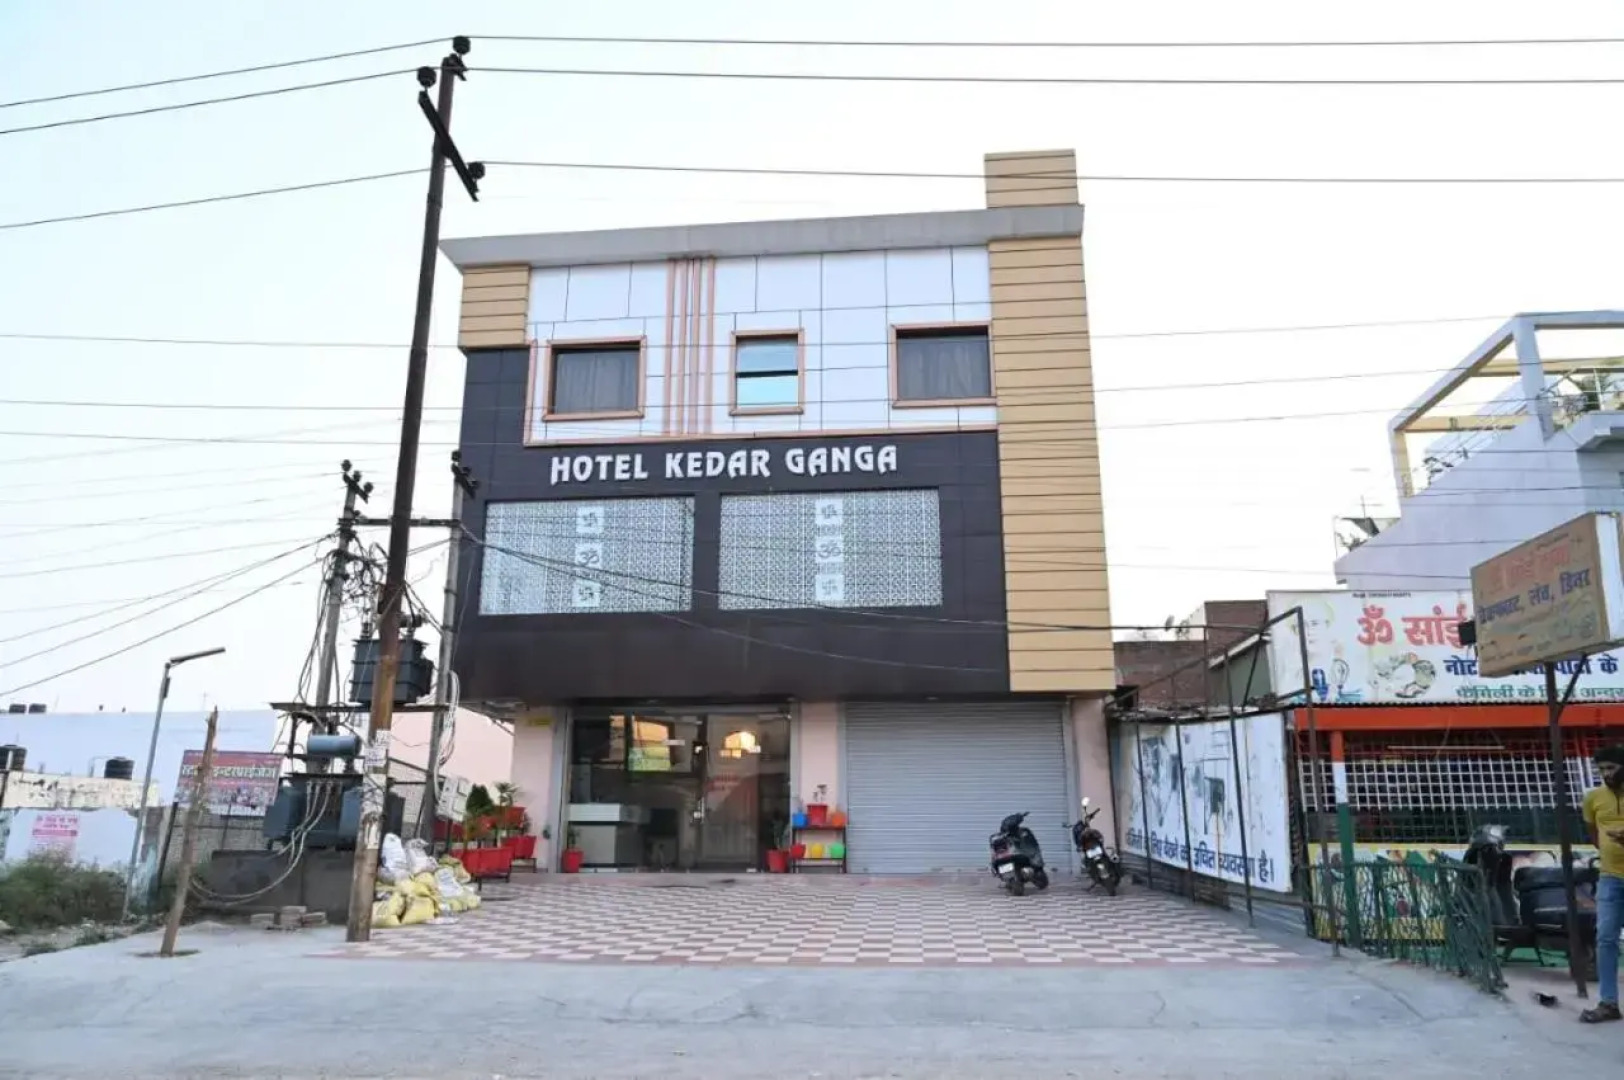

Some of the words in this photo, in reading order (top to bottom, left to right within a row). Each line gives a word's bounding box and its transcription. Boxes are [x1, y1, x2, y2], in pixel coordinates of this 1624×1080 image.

[551, 453, 649, 486] HOTEL
[665, 450, 771, 479] KEDAR
[785, 445, 898, 478] GANGA
[1357, 604, 1393, 646] ॐ
[1597, 653, 1620, 676] के
[1517, 684, 1535, 698] के
